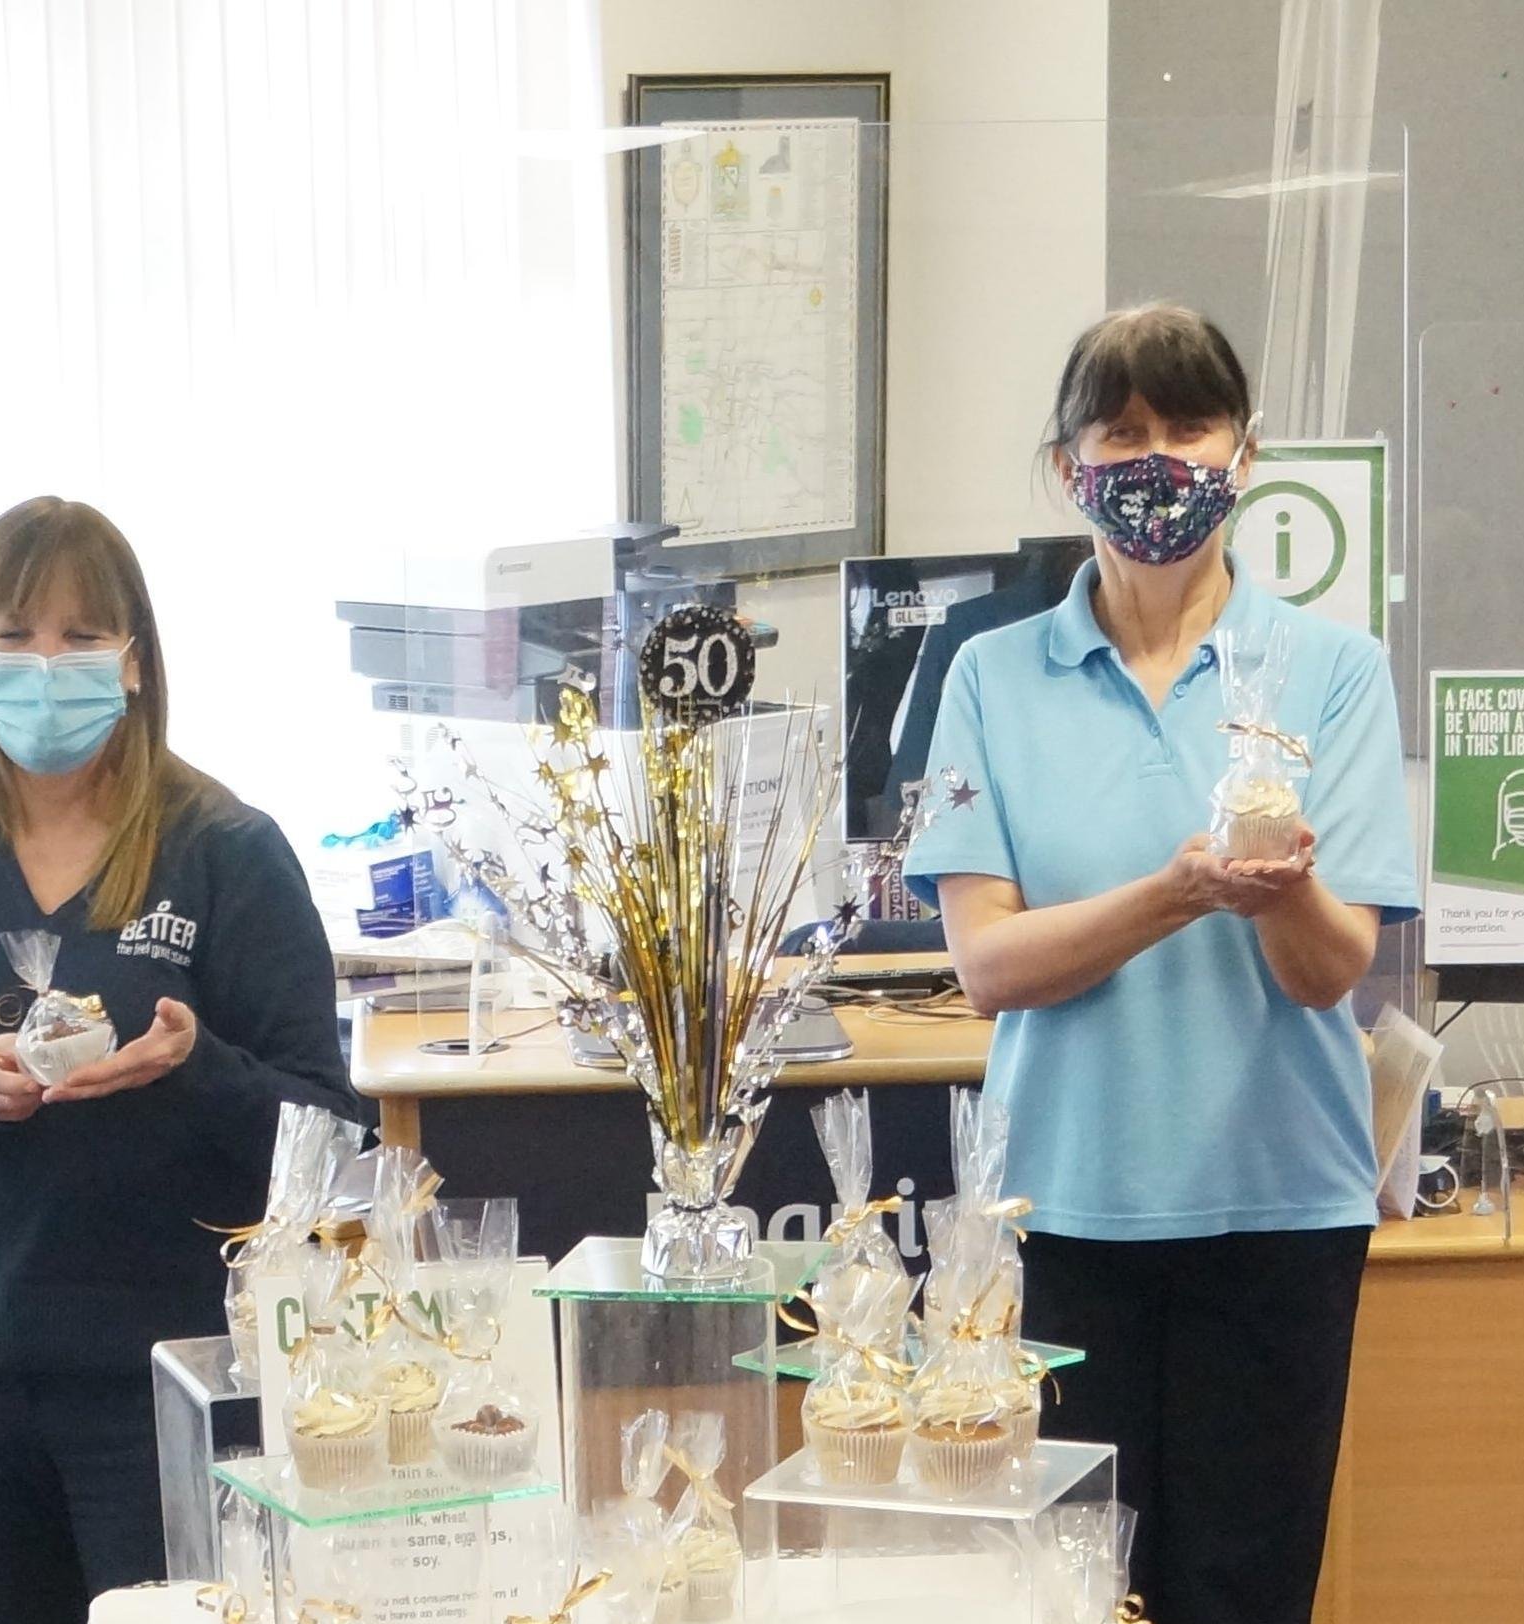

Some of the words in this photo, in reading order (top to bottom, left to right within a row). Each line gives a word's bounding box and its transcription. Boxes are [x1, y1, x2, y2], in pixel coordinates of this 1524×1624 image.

[871, 587, 959, 608] Lenovo
[659, 633, 739, 698] 50
[1444, 689, 1455, 711] A
[1459, 689, 1494, 710] FACE
[1445, 711, 1464, 734] BE
[1467, 711, 1510, 734] WORN
[1445, 734, 1461, 757] IN
[1465, 733, 1499, 756] THIS
[1441, 908, 1471, 919] Thank
[1475, 909, 1492, 920] you
[1495, 907, 1510, 919] for
[120, 909, 197, 951] BETTER
[412, 1557, 441, 1570] soy.
